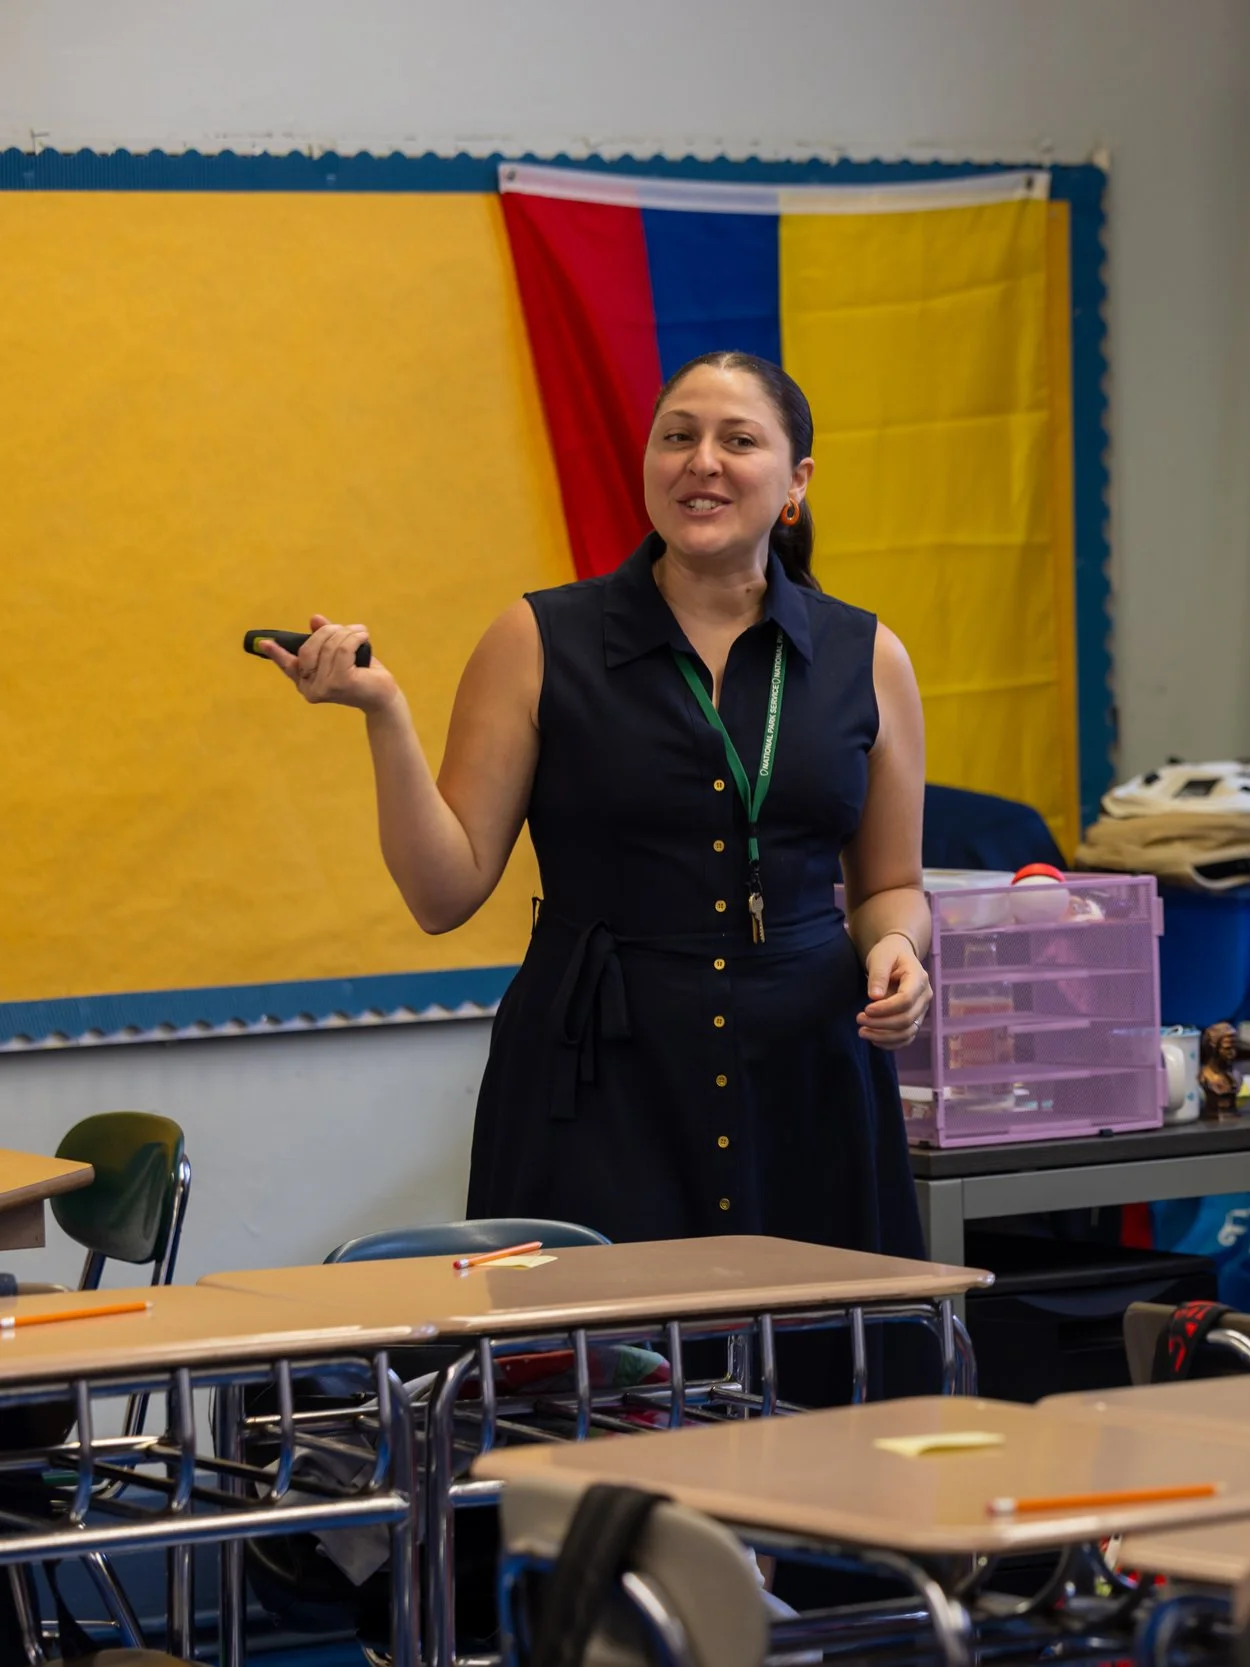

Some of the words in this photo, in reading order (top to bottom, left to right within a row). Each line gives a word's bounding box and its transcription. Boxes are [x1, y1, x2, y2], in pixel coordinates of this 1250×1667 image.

[774, 644, 783, 677] NATIONAL
[770, 684, 779, 713] SERVICE
[768, 714, 776, 733] PARK
[763, 734, 773, 769] NATIONAL
